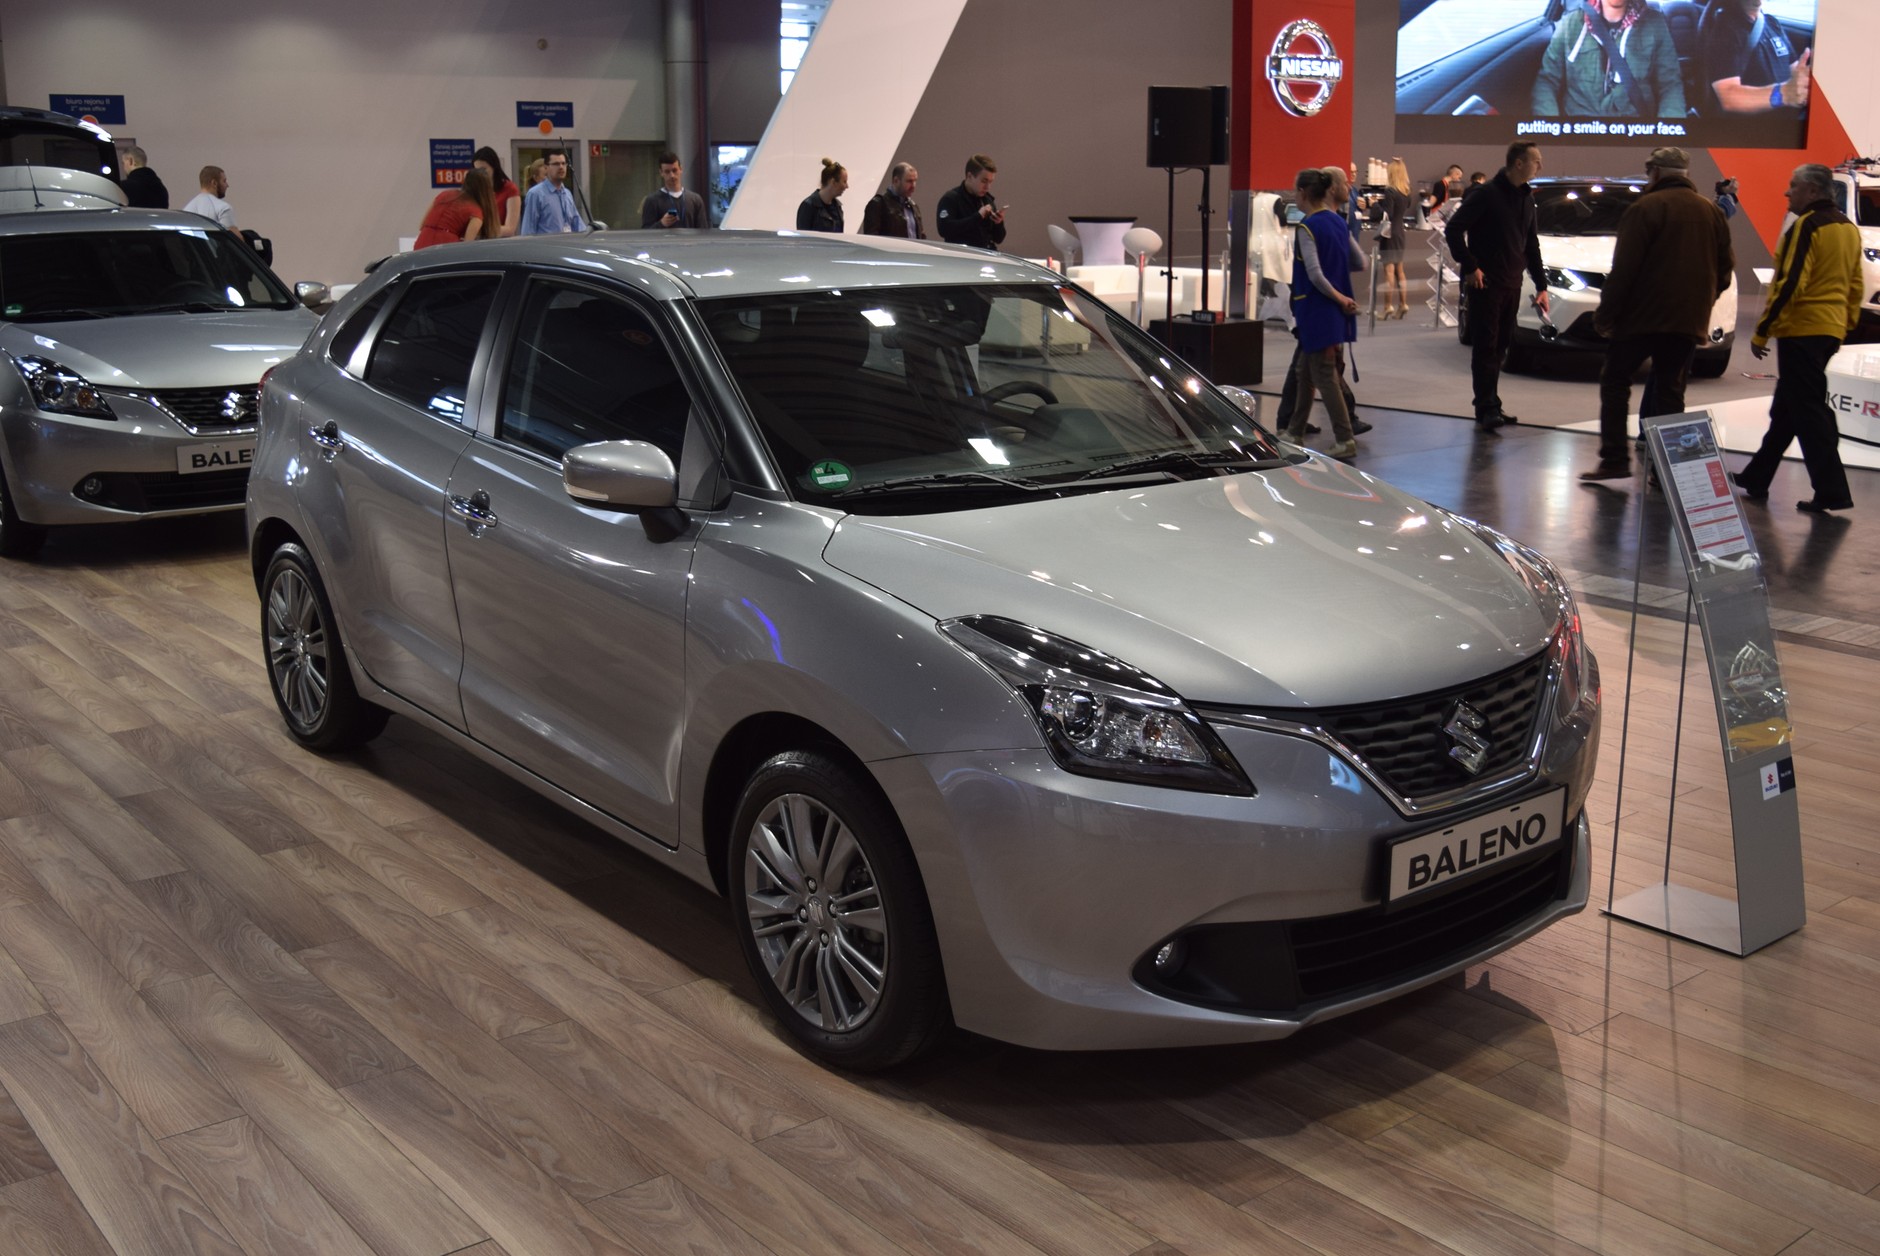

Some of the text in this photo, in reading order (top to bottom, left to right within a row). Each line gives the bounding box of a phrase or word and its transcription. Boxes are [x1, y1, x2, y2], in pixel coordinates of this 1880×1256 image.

[1281, 58, 1340, 77] NISSAN
[1517, 121, 1686, 136] putting a smile on your face.
[824, 462, 836, 475] 4
[1408, 813, 1546, 890] BALENO
